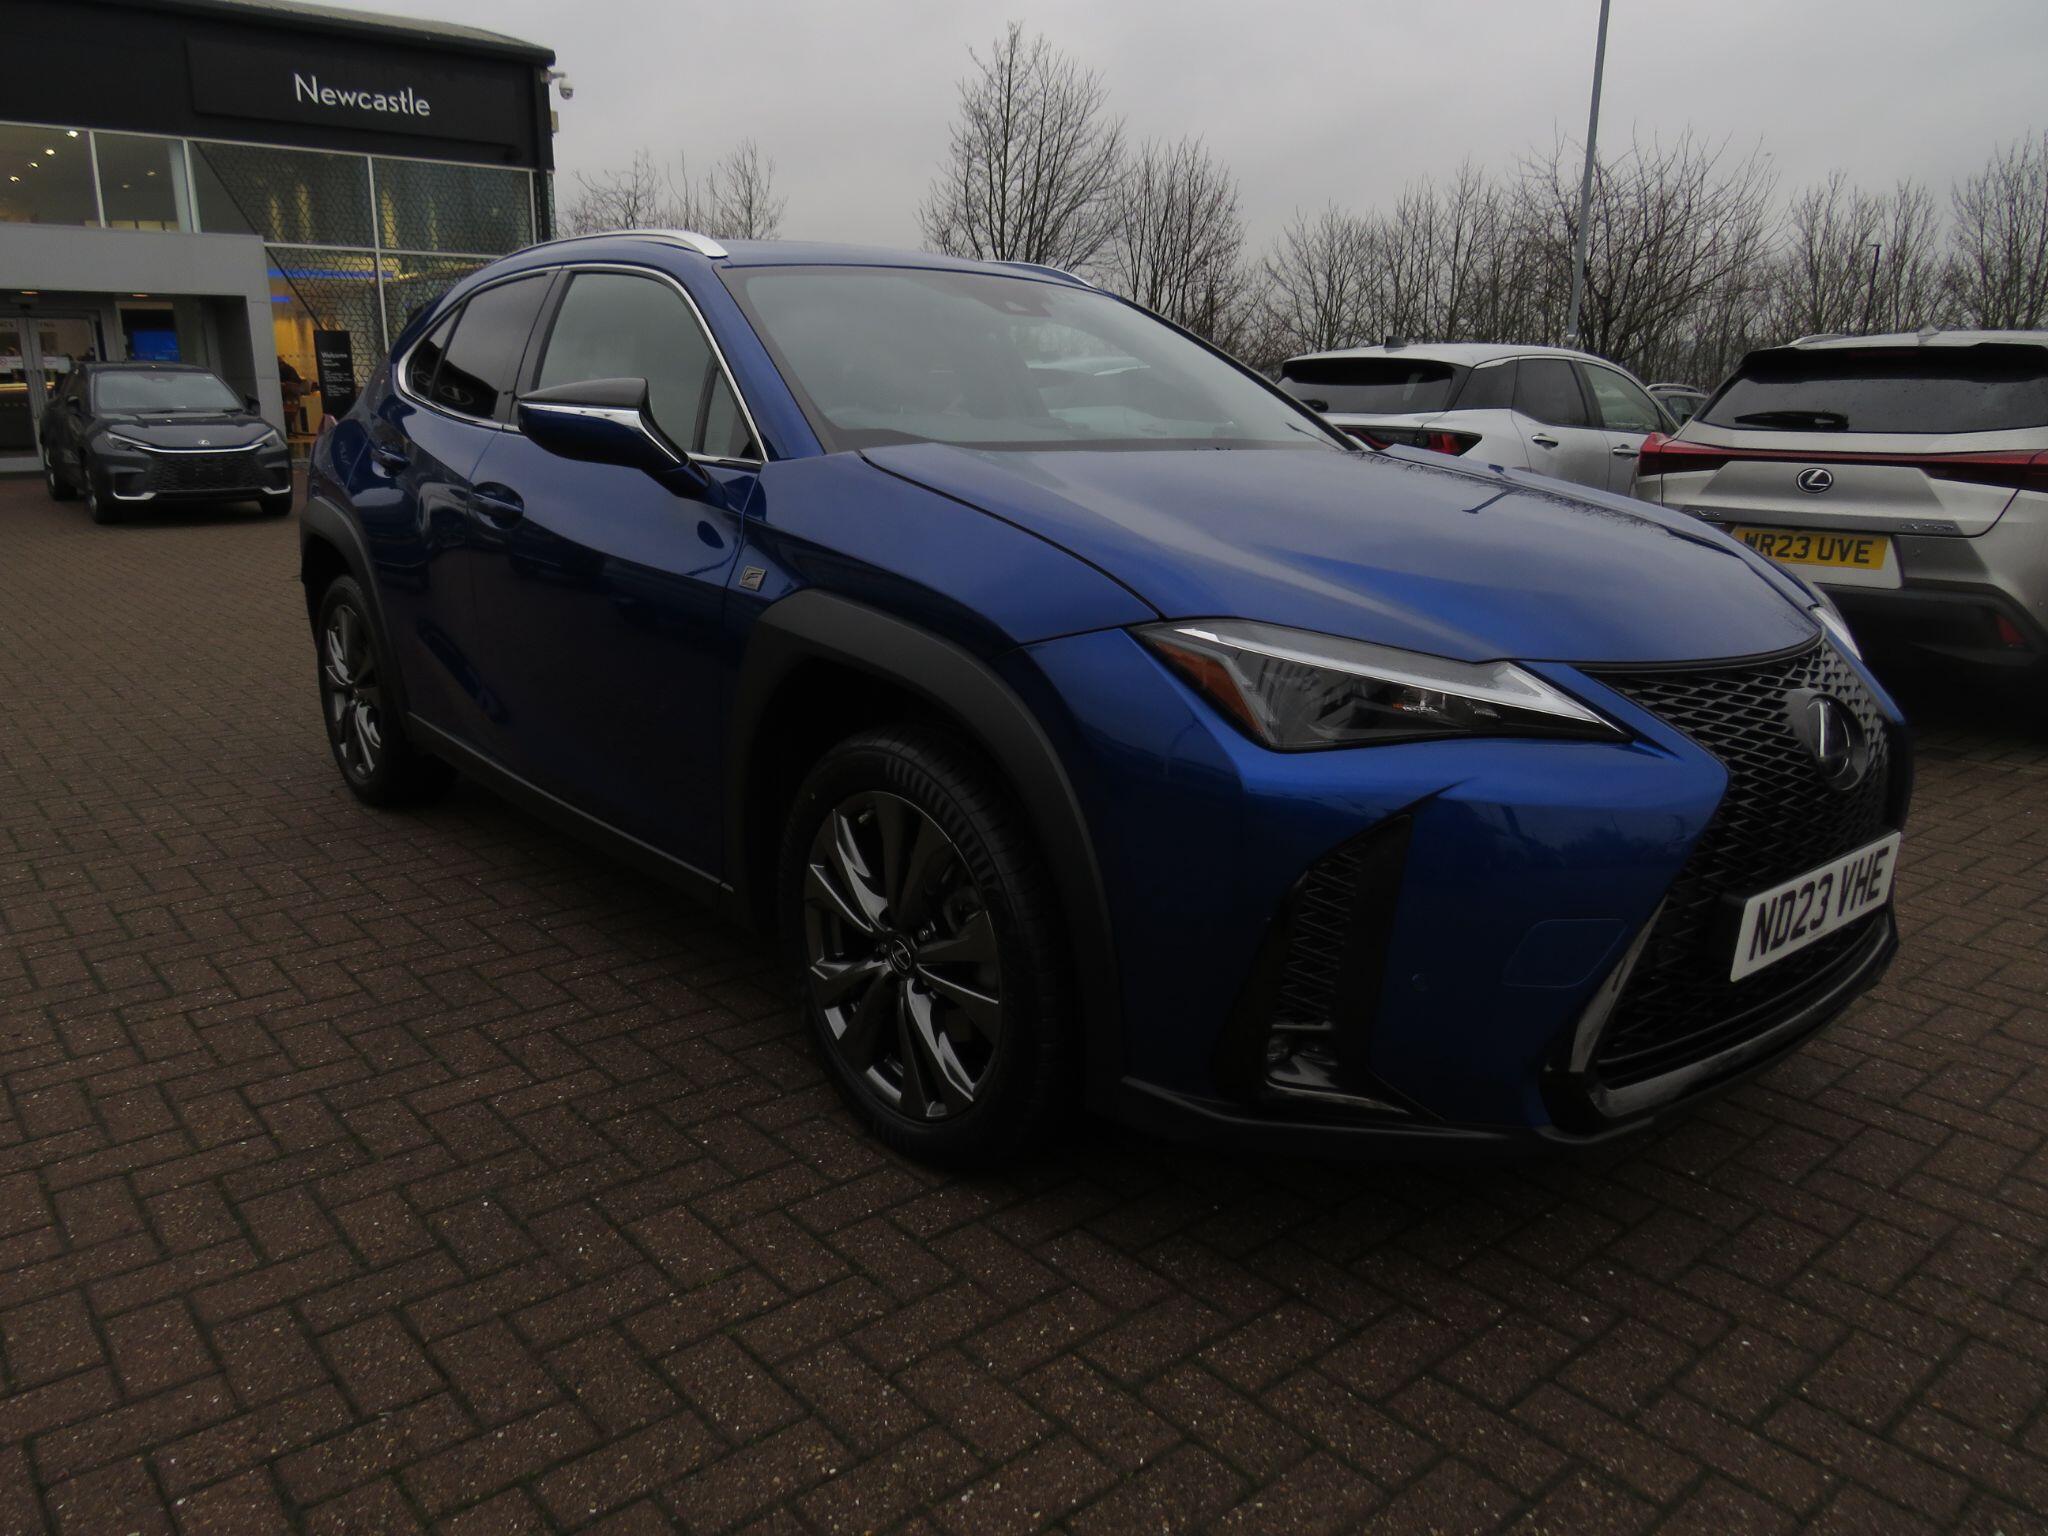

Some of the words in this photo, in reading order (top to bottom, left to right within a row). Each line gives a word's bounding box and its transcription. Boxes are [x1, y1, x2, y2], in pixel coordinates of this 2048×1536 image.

[294, 72, 431, 116] Newcastle
[1817, 537, 1873, 563] UVE
[1748, 873, 1833, 961] ND23
[1837, 846, 1890, 917] VHE
